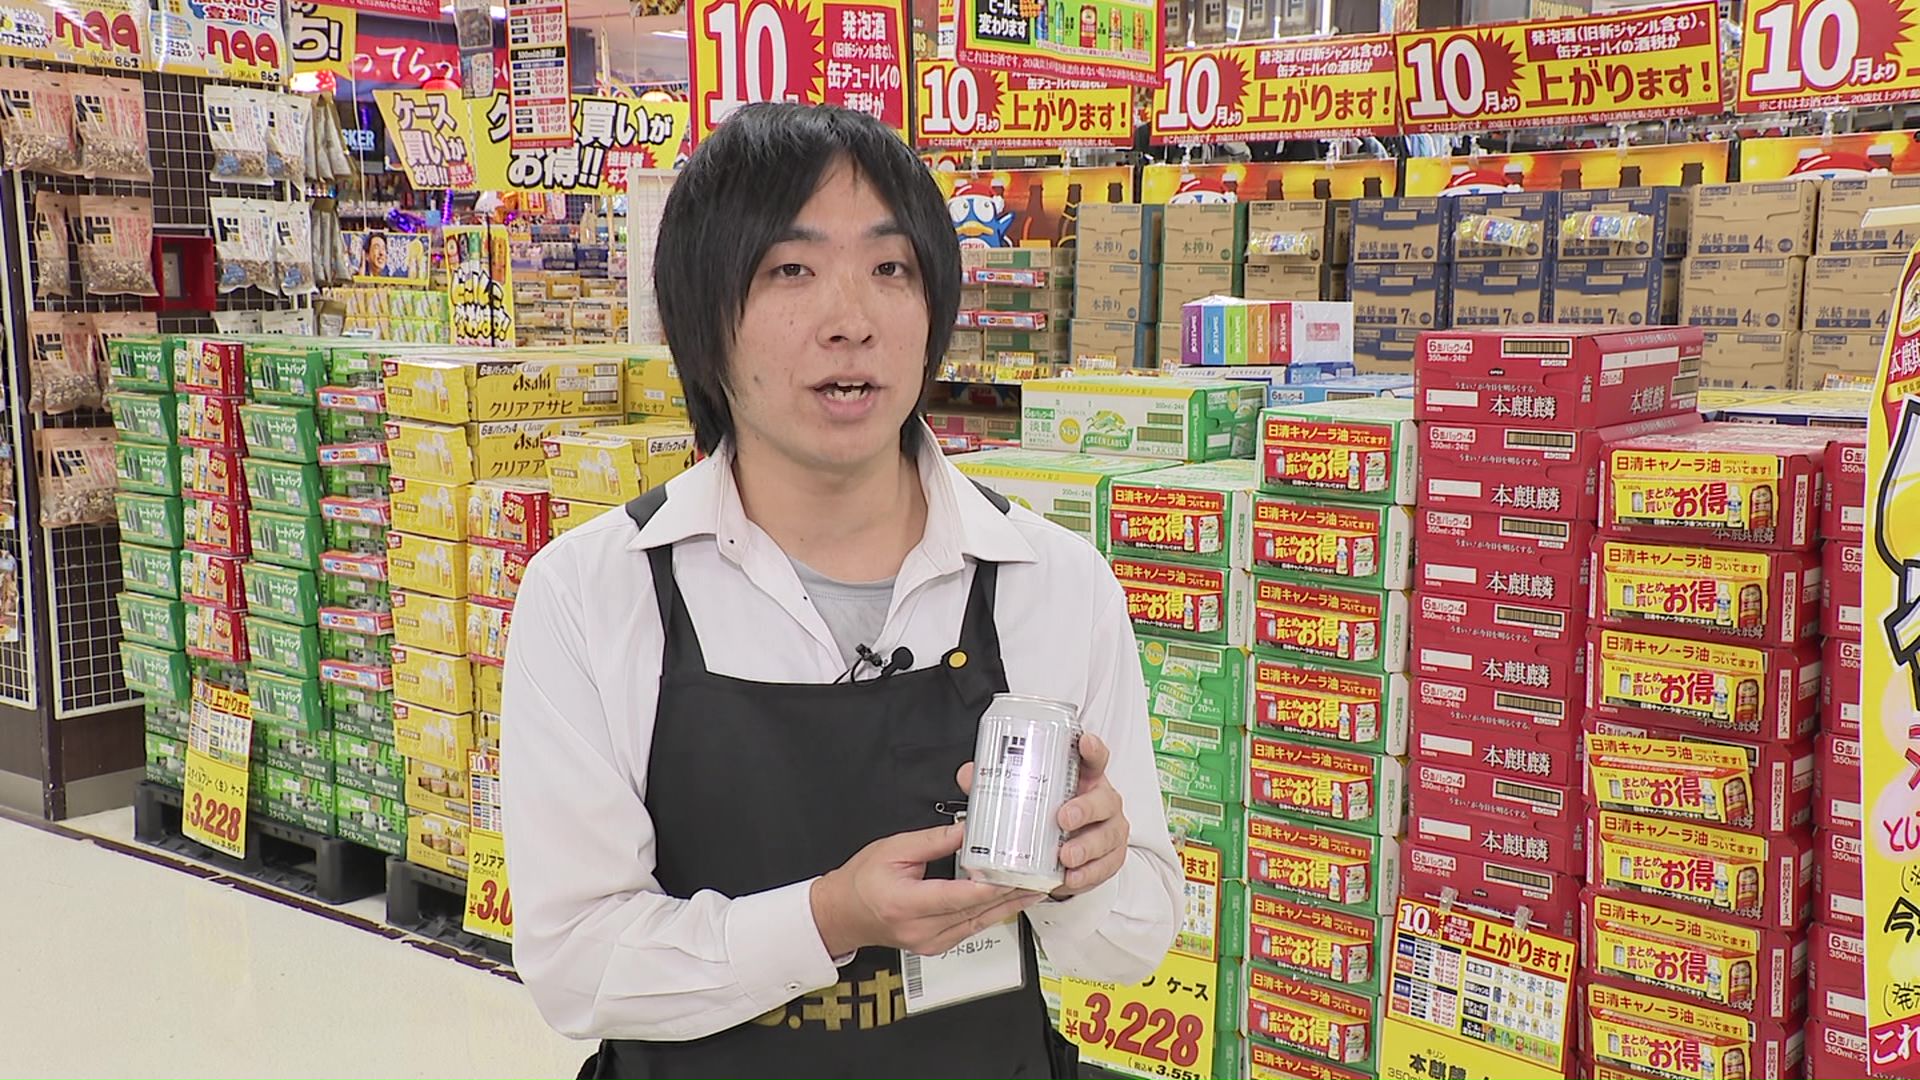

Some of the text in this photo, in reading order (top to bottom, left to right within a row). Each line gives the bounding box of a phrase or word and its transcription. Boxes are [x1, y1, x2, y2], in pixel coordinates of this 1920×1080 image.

[842, 10, 887, 41] 発泡酒
[978, 13, 1028, 41] 変わります
[1556, 33, 1682, 60] 缶チューハイの酒税が
[827, 60, 900, 90] 缶チューハイの
[1525, 60, 1713, 109] 上がります!
[391, 94, 457, 131] ケース
[1004, 92, 1127, 132] 上がります!
[1247, 79, 1392, 124] 上がります!
[401, 129, 467, 166] 買いが
[508, 147, 605, 188] お得!!
[513, 373, 551, 391] Asahi
[489, 399, 574, 417] クリアアサヒ
[1489, 394, 1557, 420] 本麒麟
[1268, 422, 1387, 446] 日清キャノーラ油 ついてます!
[490, 460, 545, 477] クリアア
[1286, 451, 1309, 463] まとめ
[1307, 449, 1349, 480] お得
[1616, 457, 1721, 473] 日清キャノーラ油
[1114, 488, 1187, 505] 日清キャノーラ油
[1491, 483, 1561, 511] 本麒麟
[1672, 481, 1728, 518] お得
[1148, 512, 1184, 542] お得
[1257, 502, 1375, 530] 日清キャノーラ油 ついてます!
[1275, 535, 1298, 549] まとめ
[1296, 532, 1337, 564] お得
[1260, 583, 1376, 615] 日清キャノーラ油 ついてます!
[1485, 569, 1556, 600] 本麒麟
[1277, 617, 1299, 631] まとめ
[1297, 616, 1338, 647] お得
[1259, 667, 1377, 697] 日清キャノーラ油 ついてます!
[1481, 657, 1552, 689] 本麒麟
[1277, 699, 1299, 713] まとめ
[1297, 699, 1339, 729] お得
[1253, 744, 1369, 774] 日清キャノーラ油 ついてます!
[1481, 744, 1552, 777] 本麒麟
[1271, 777, 1293, 790] まとめ
[1291, 776, 1333, 807] お得
[190, 792, 242, 842] 3,228
[1251, 822, 1367, 858] 日清キャノーラ油 ついてます!
[1480, 829, 1550, 863] 本麒麟
[1268, 857, 1291, 871] まとめ
[1289, 857, 1331, 887] お得
[1255, 900, 1369, 939] 日清キャノーラ油 ついてます!
[1271, 934, 1293, 949] まとめ
[1290, 938, 1332, 968] お得
[1474, 924, 1571, 973] 上がります!
[1166, 976, 1209, 1002] ケース
[1079, 992, 1203, 1068] 3,228
